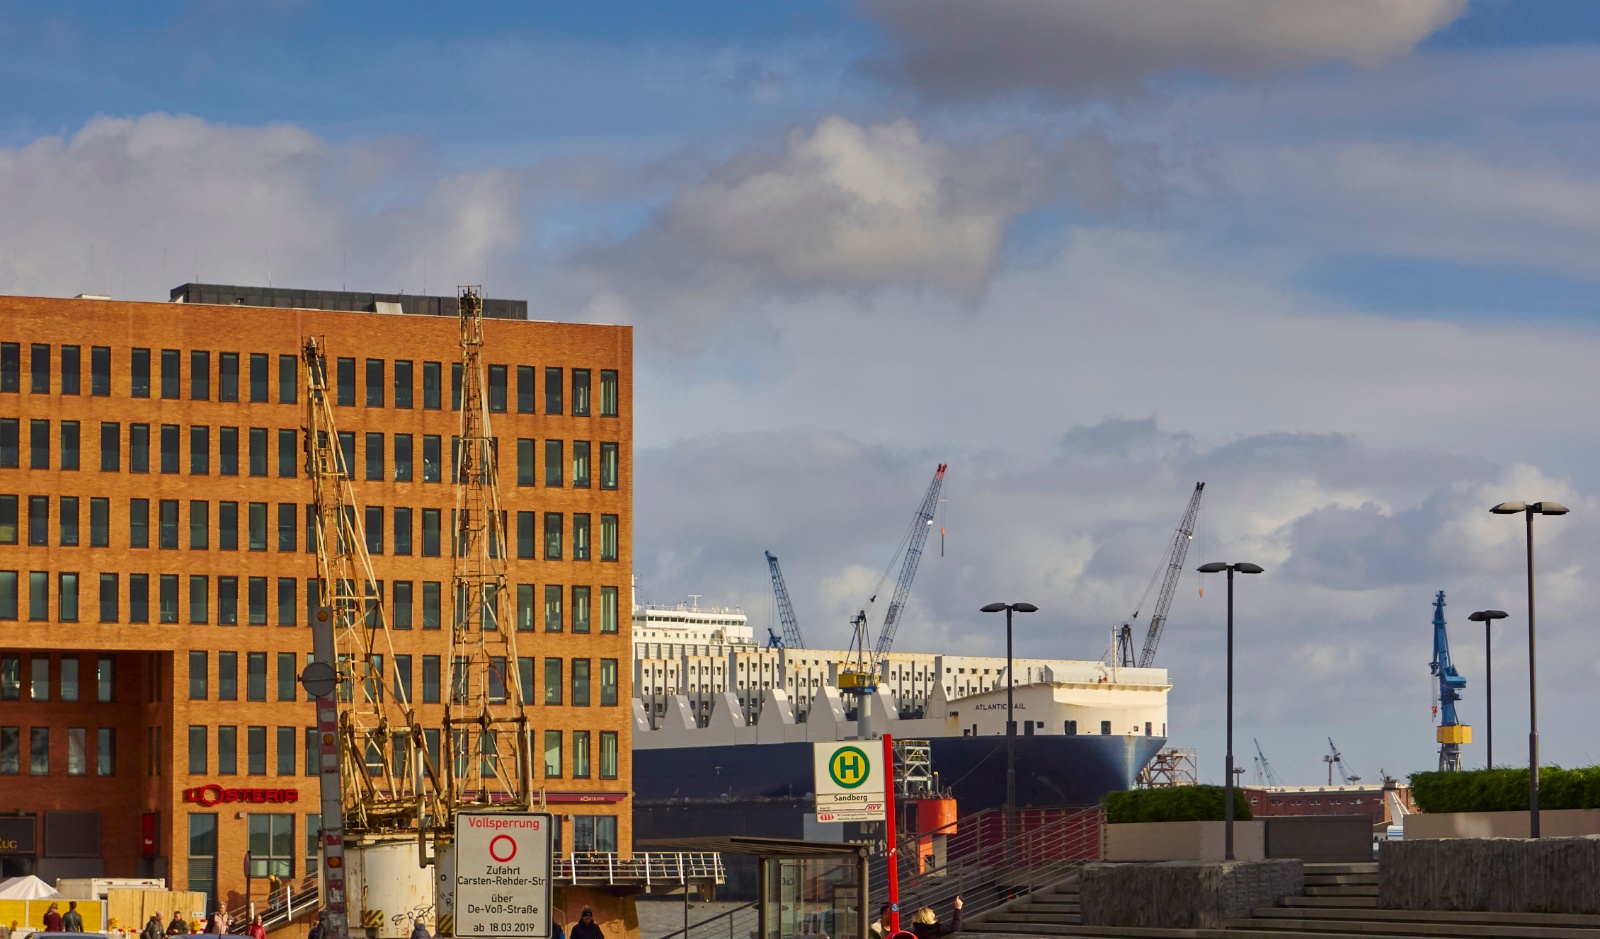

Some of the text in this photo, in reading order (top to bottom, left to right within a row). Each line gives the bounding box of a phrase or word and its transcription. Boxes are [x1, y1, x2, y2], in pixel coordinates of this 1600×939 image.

[839, 755, 860, 779] H
[833, 794, 868, 802] Sandberg
[468, 817, 540, 831] Vollsperrung
[486, 865, 521, 875] Zufahrt
[457, 876, 548, 886] Carsten-Rehder-Str.
[491, 894, 514, 903] über
[467, 904, 539, 914] De-Voß-Straße
[473, 923, 535, 933] ab 18.03.2019
